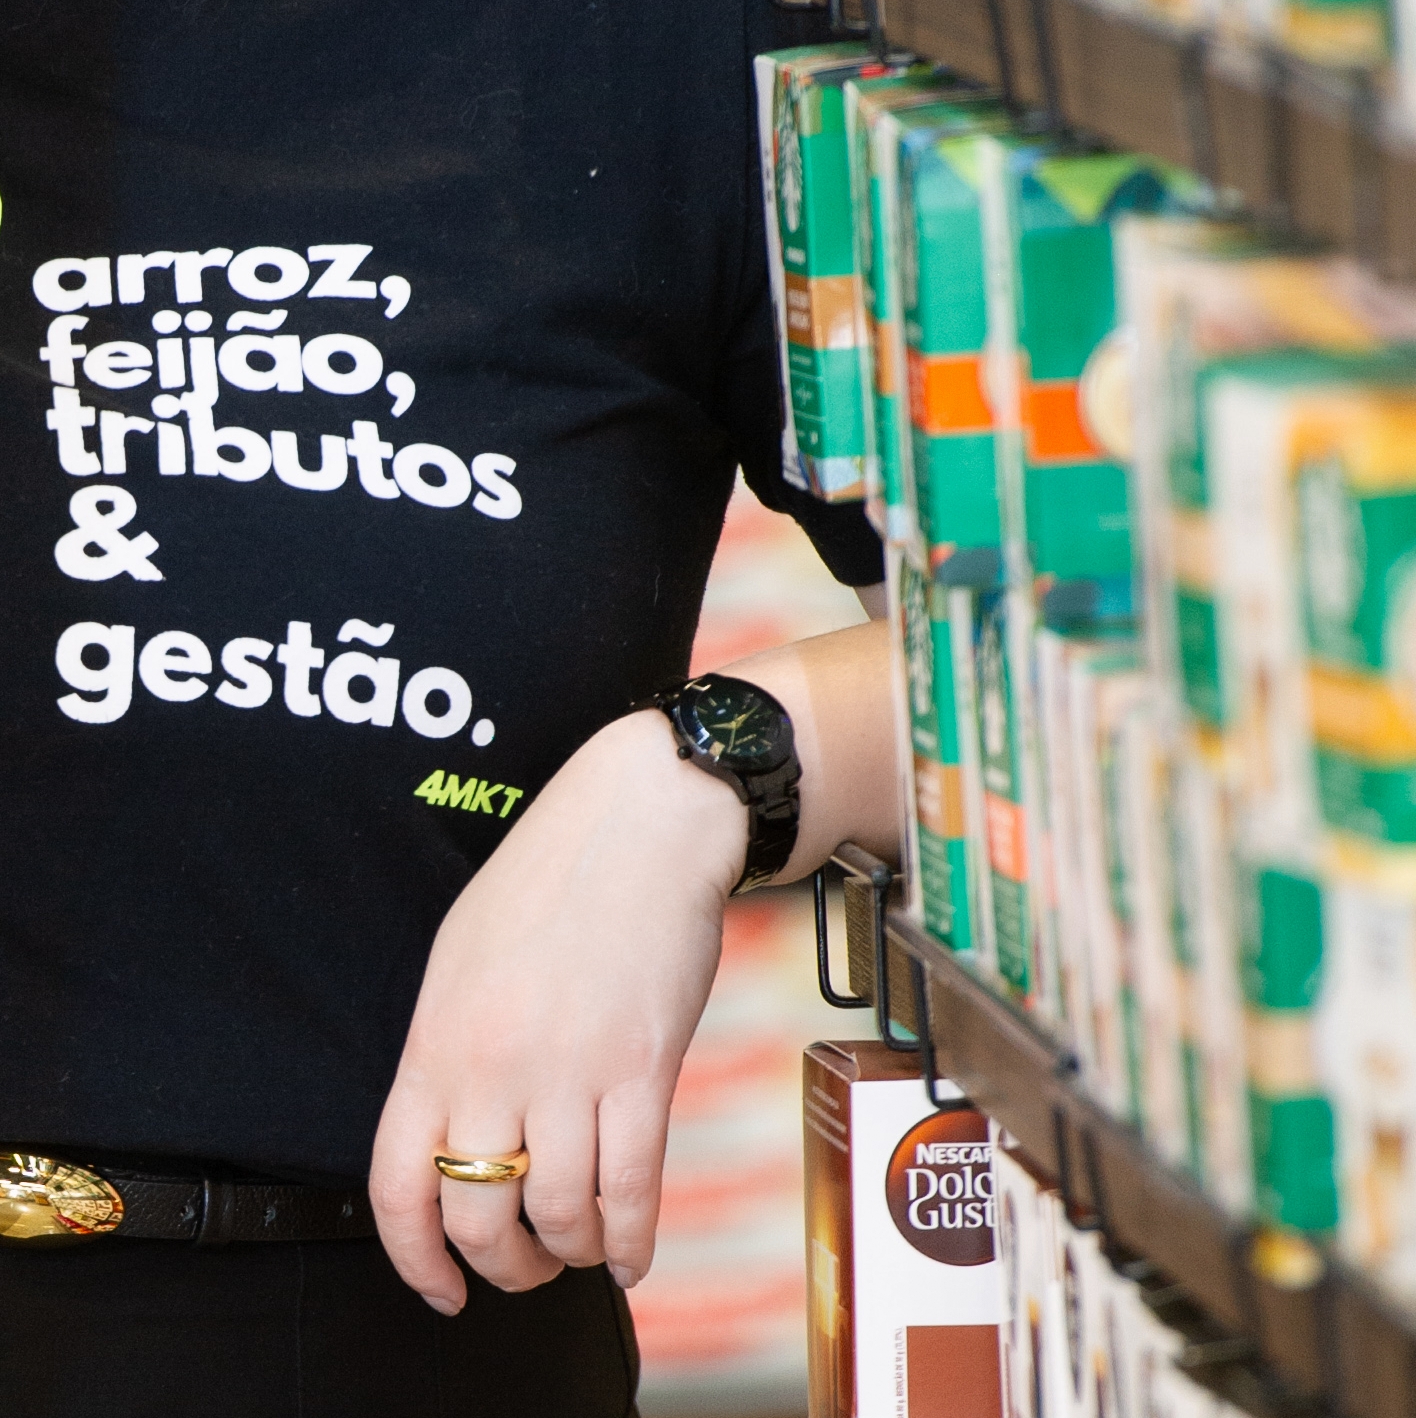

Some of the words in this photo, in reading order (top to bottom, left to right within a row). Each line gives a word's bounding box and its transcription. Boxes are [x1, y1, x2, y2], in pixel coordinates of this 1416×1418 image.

[32, 244, 412, 318] arroz,
[40, 309, 416, 417] feijão,
[47, 386, 523, 520] tributos
[54, 484, 164, 582] &
[55, 618, 496, 747] gestão.
[413, 769, 524, 818] 4MKT
[905, 1165, 995, 1201] Dolc
[915, 1142, 993, 1165] NESCAF
[908, 1198, 996, 1230] Gust
